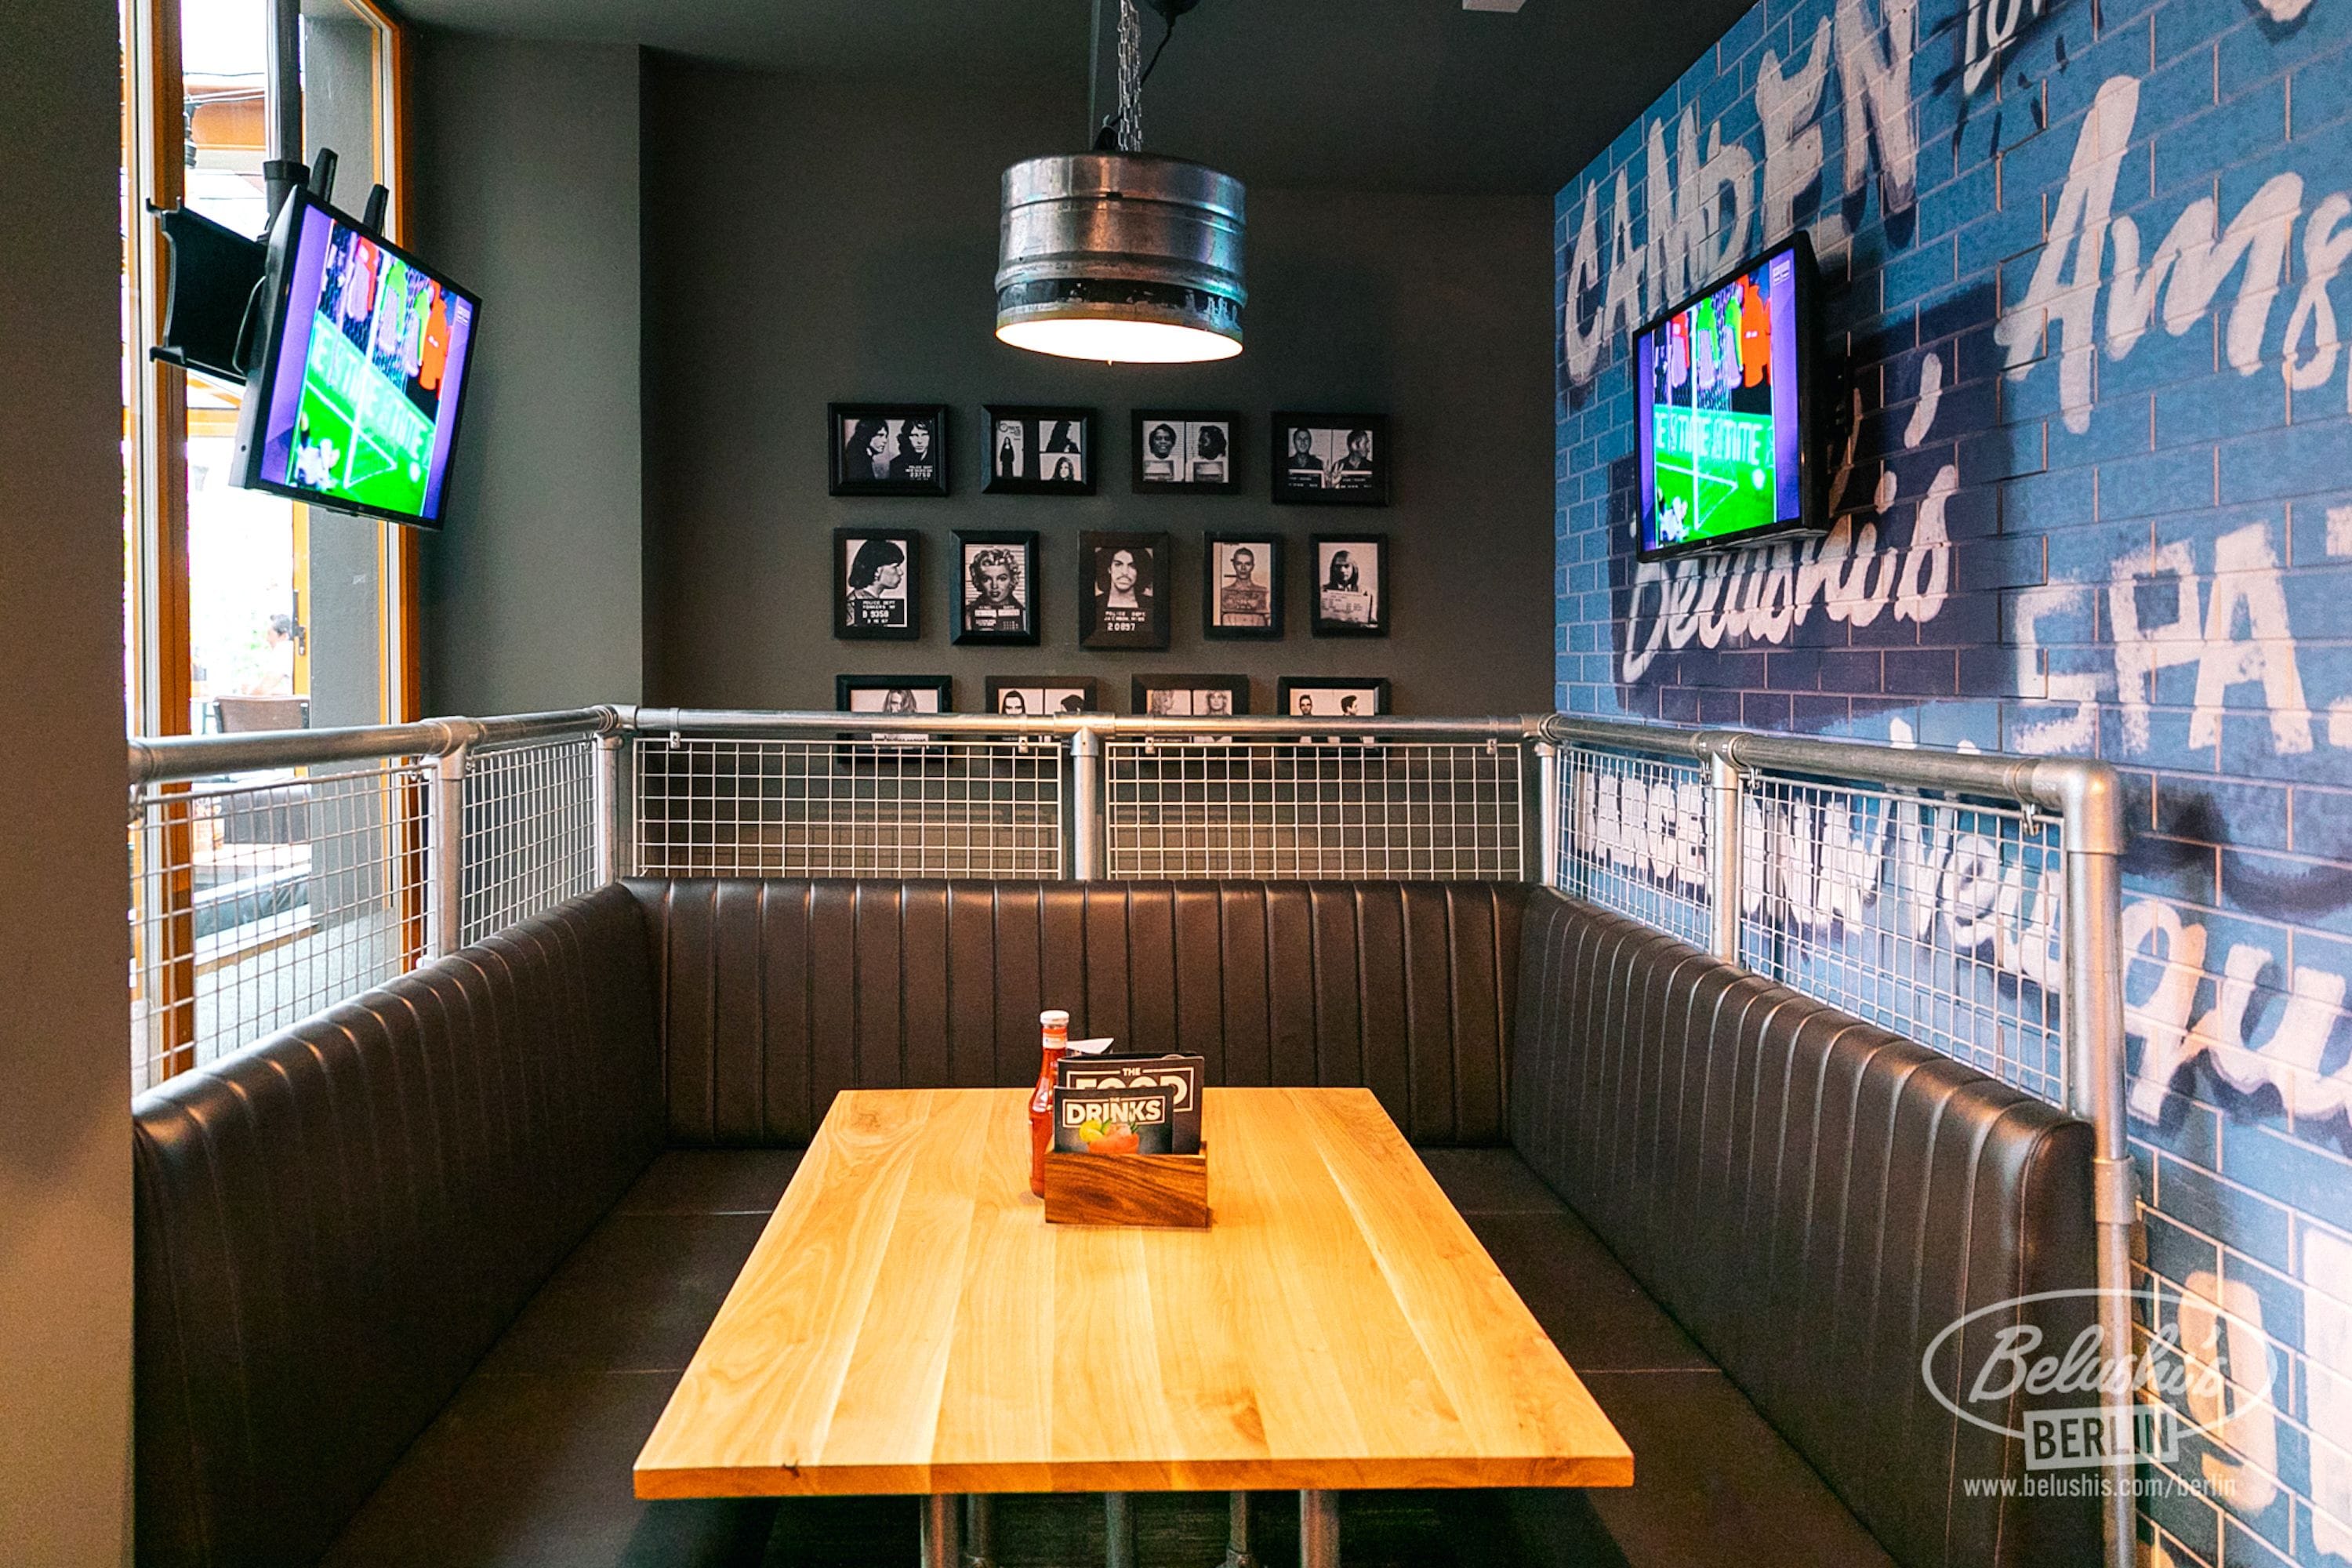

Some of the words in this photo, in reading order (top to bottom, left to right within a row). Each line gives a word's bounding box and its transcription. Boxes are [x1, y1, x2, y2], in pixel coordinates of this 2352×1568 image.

[1564, 0, 1918, 387] CAMDEN
[1993, 74, 2352, 434] Ams
[1066, 1099, 1162, 1124] DRINKS
[1123, 1067, 1142, 1076] THE
